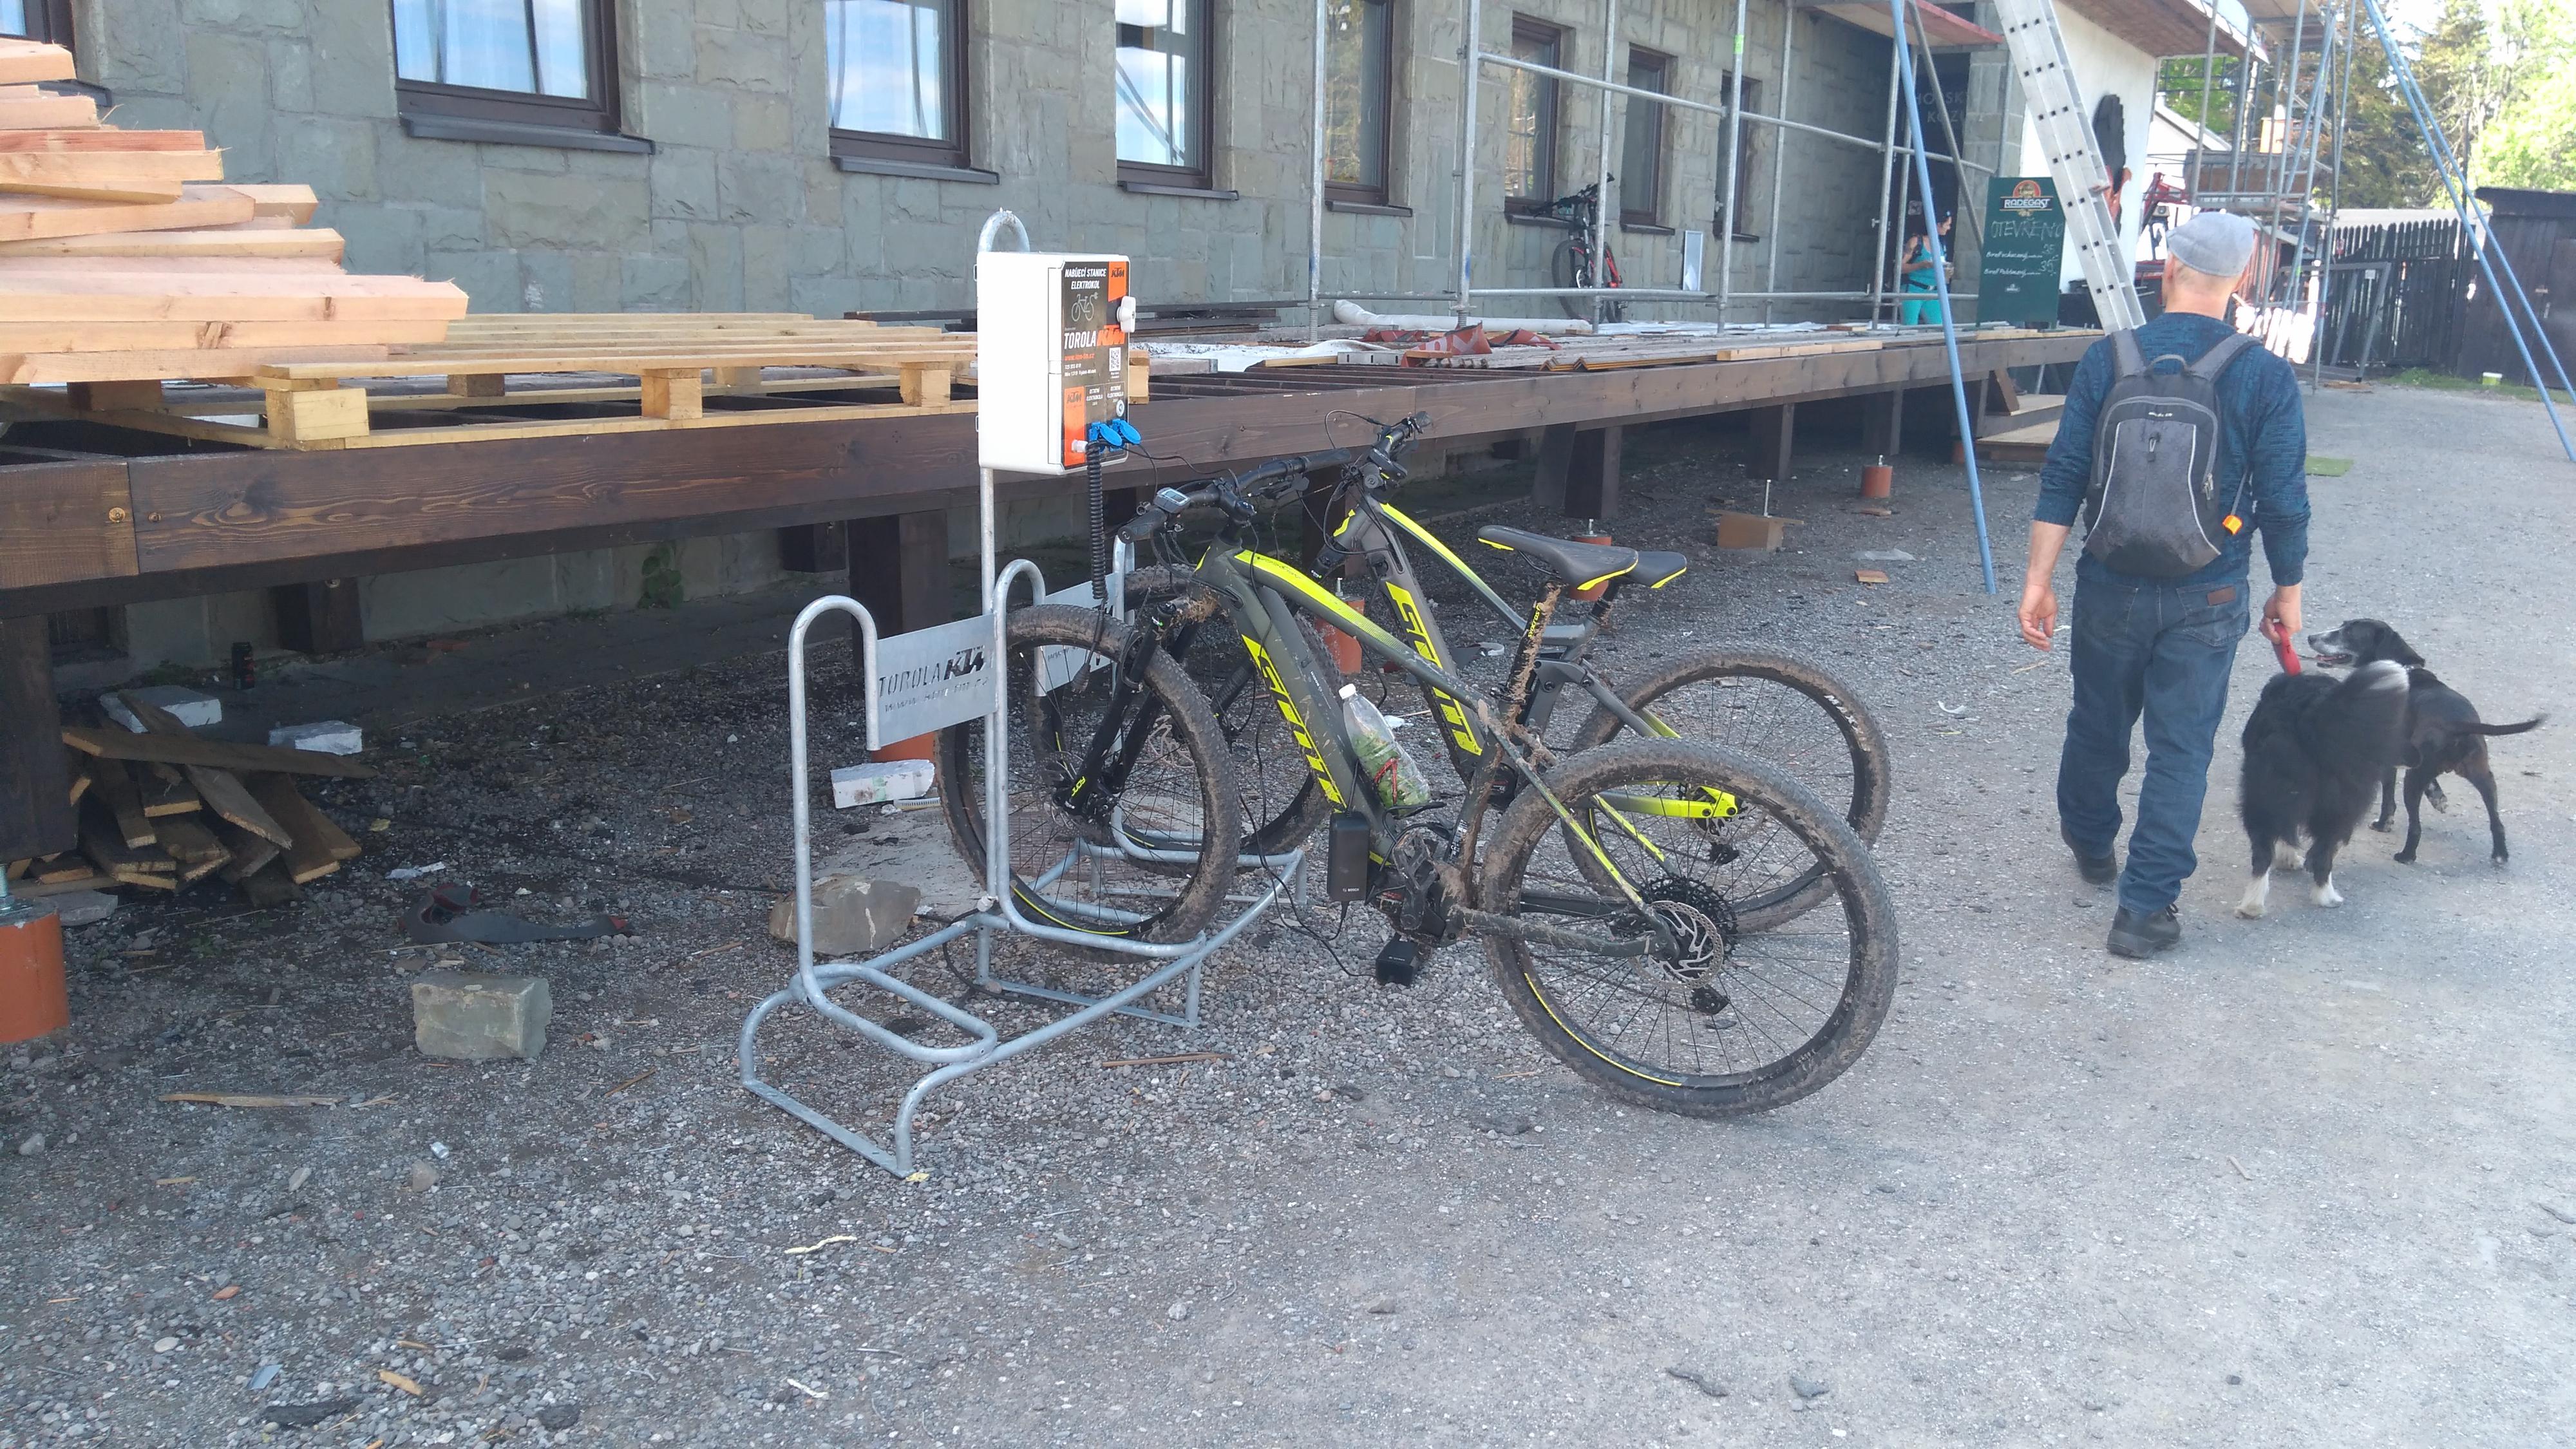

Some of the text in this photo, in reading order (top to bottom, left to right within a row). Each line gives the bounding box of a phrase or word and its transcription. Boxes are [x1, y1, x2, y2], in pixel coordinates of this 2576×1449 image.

[2004, 198, 2050, 209] RADEGAST
[1065, 267, 1107, 278] NABÍJECÍ STANICE
[1111, 267, 1125, 278] KTM
[1071, 281, 1100, 290] ELEKTROKOL
[1064, 325, 1126, 350] TOROLA KTM
[879, 663, 941, 698] TOROLA
